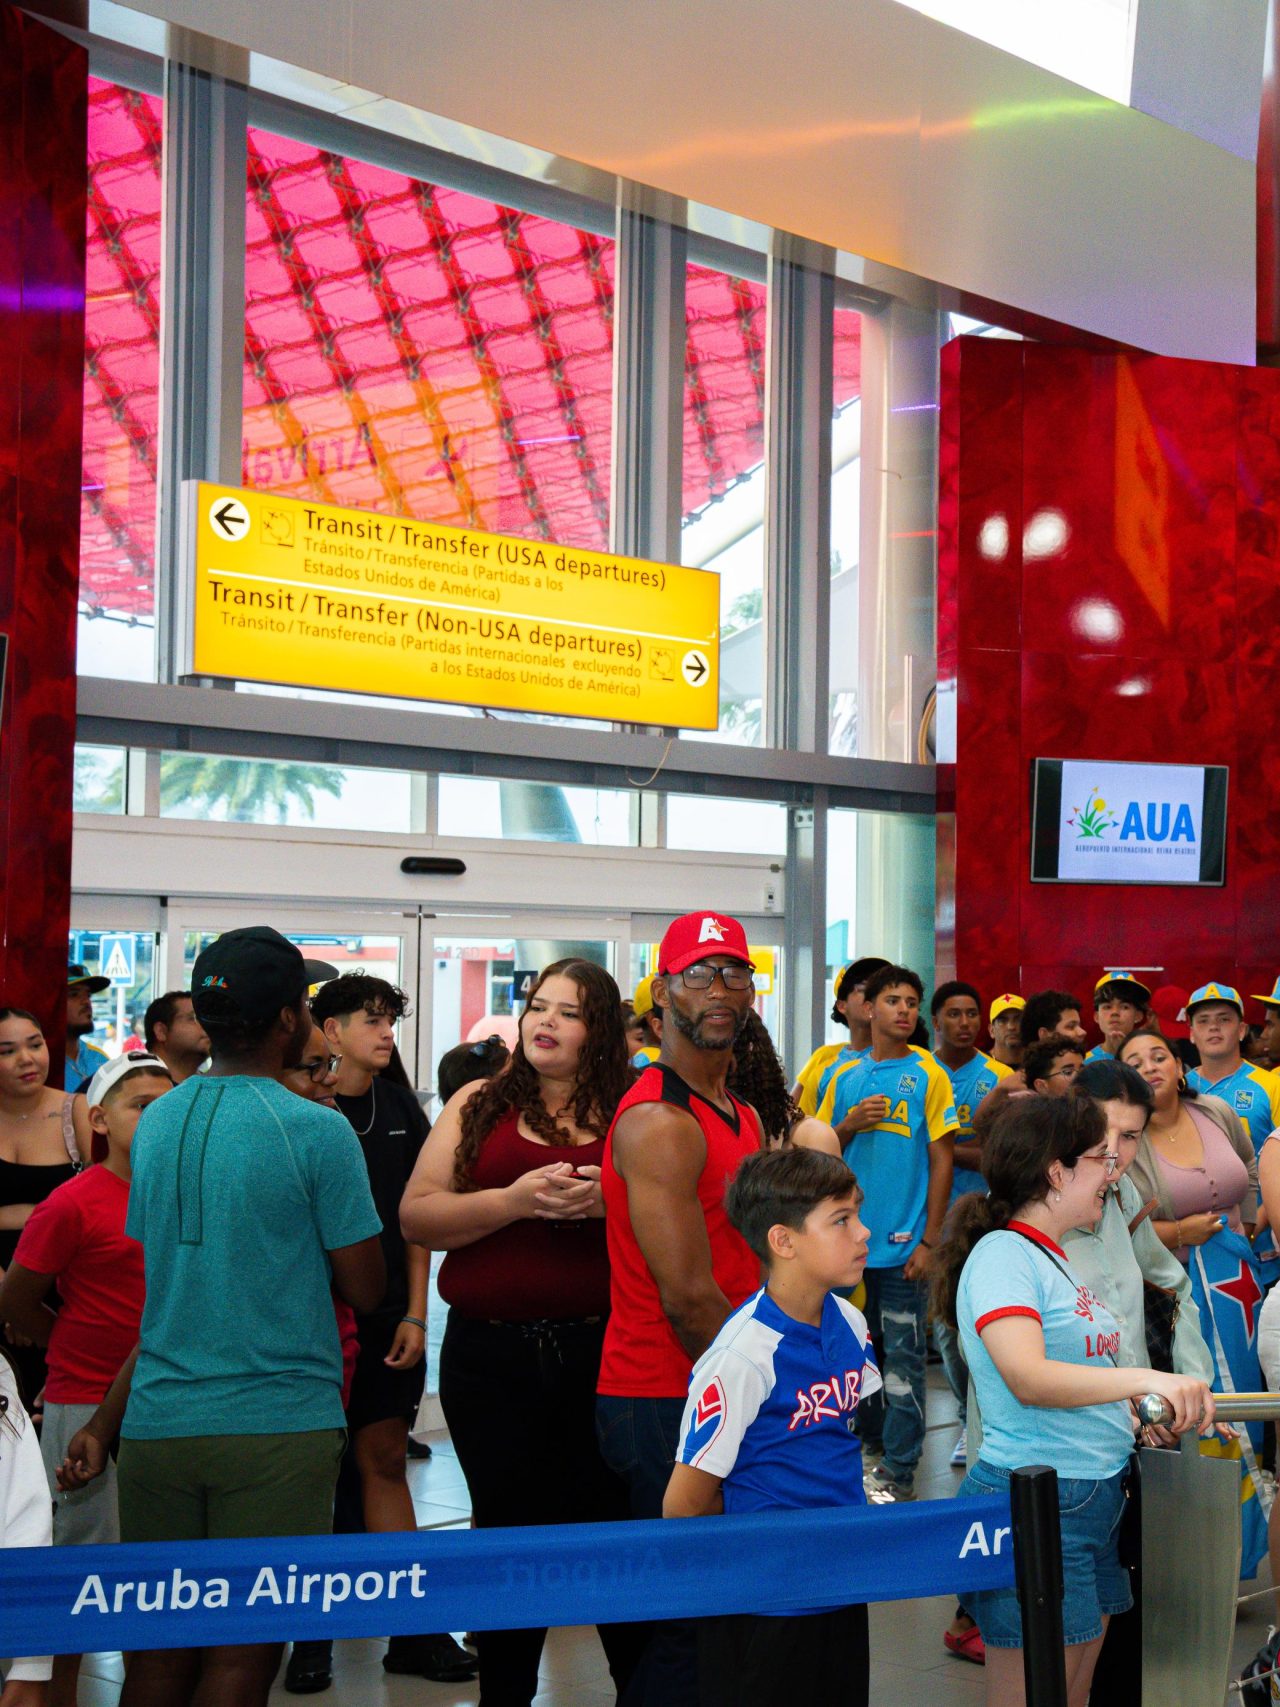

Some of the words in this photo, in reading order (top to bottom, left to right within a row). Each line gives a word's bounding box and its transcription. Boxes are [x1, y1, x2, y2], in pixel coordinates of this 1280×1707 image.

[303, 509, 382, 541] Transit
[400, 526, 489, 559] Transfer
[497, 541, 547, 569] (USA
[555, 552, 666, 591] departures)
[304, 559, 360, 581] Estados
[364, 568, 415, 590] Unidos
[418, 577, 436, 592] de
[440, 580, 501, 603] América)
[473, 565, 531, 587] (Partidas
[534, 579, 542, 588] a
[546, 577, 563, 591] los
[208, 580, 295, 612] Transit
[313, 595, 409, 626] Transfer
[417, 608, 521, 642] (Non-USA
[529, 625, 642, 661] departures)
[400, 633, 461, 656] (Partidas
[466, 643, 565, 669] internacionales
[573, 658, 642, 680] excluyendo
[430, 662, 438, 673] a
[443, 660, 462, 676] los
[466, 663, 517, 683] Estados
[520, 670, 564, 689] Unidos
[568, 676, 583, 690] de
[586, 679, 641, 698] América)
[1119, 801, 1196, 842] AUA
[698, 917, 725, 943] A
[520, 975, 532, 995] 4
[788, 1364, 866, 1431] ARUB
[70, 1568, 230, 1615] Aruba
[246, 1563, 427, 1612] Airport
